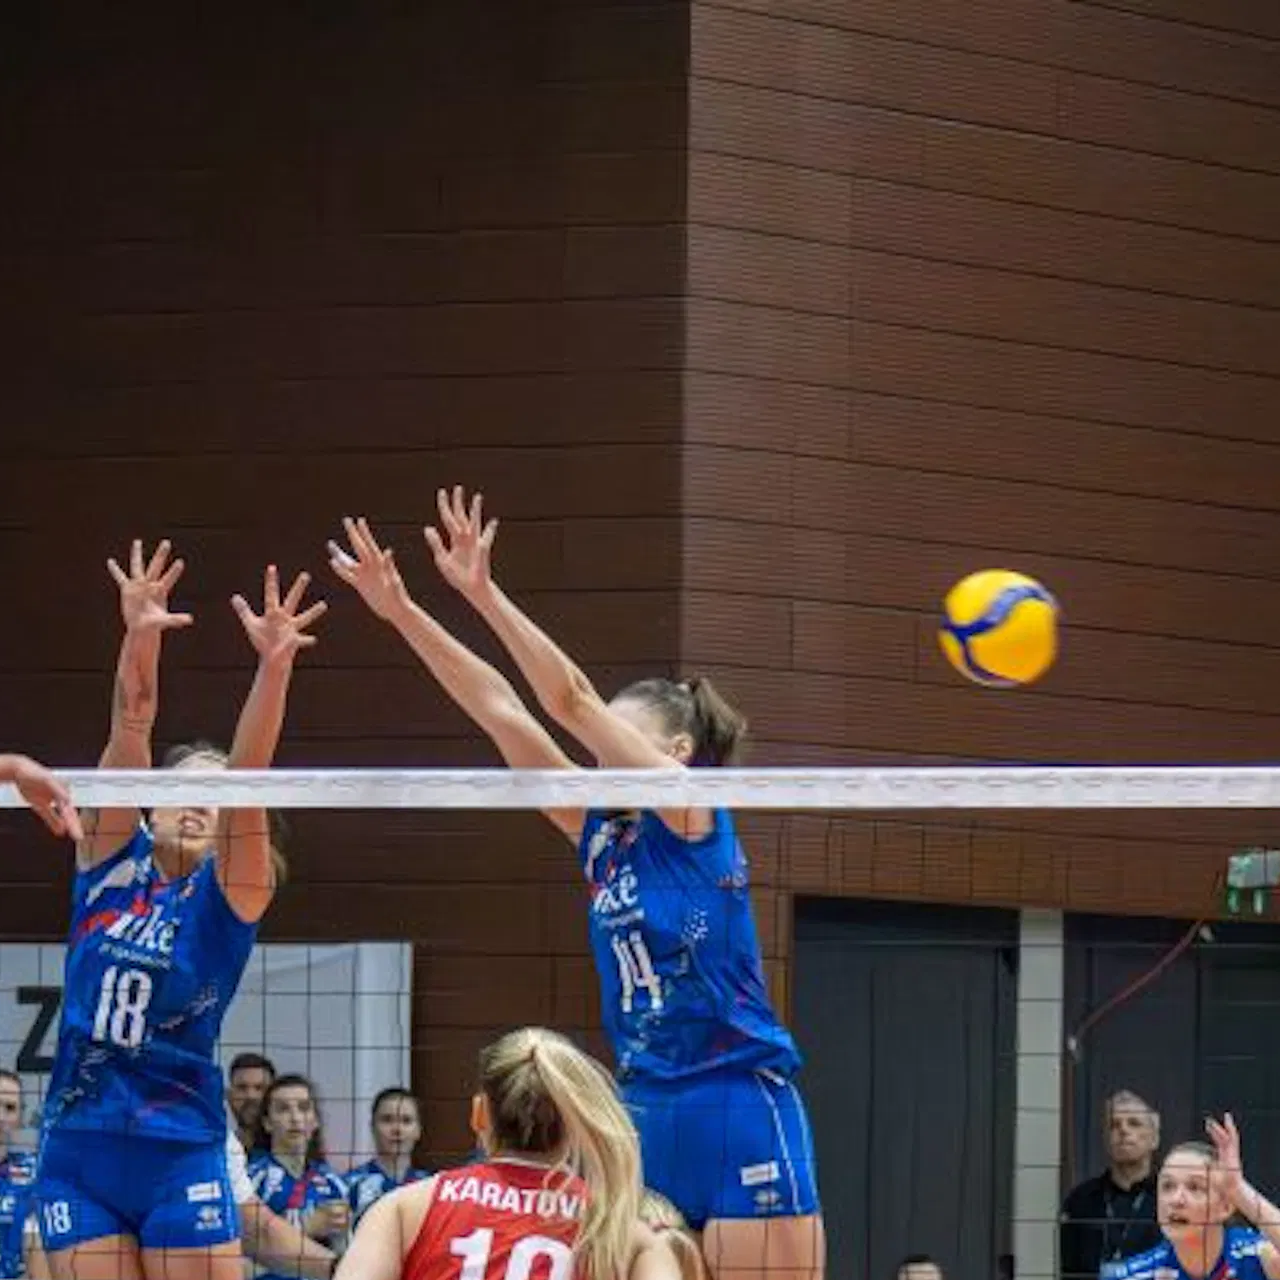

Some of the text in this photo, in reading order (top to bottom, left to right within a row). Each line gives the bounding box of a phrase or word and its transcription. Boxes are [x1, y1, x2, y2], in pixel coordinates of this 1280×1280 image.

[91, 965, 152, 1048] 18
[611, 930, 663, 1013] 14
[17, 985, 63, 1072] Z
[43, 1201, 72, 1237] 18
[440, 1177, 579, 1219] KARATOV
